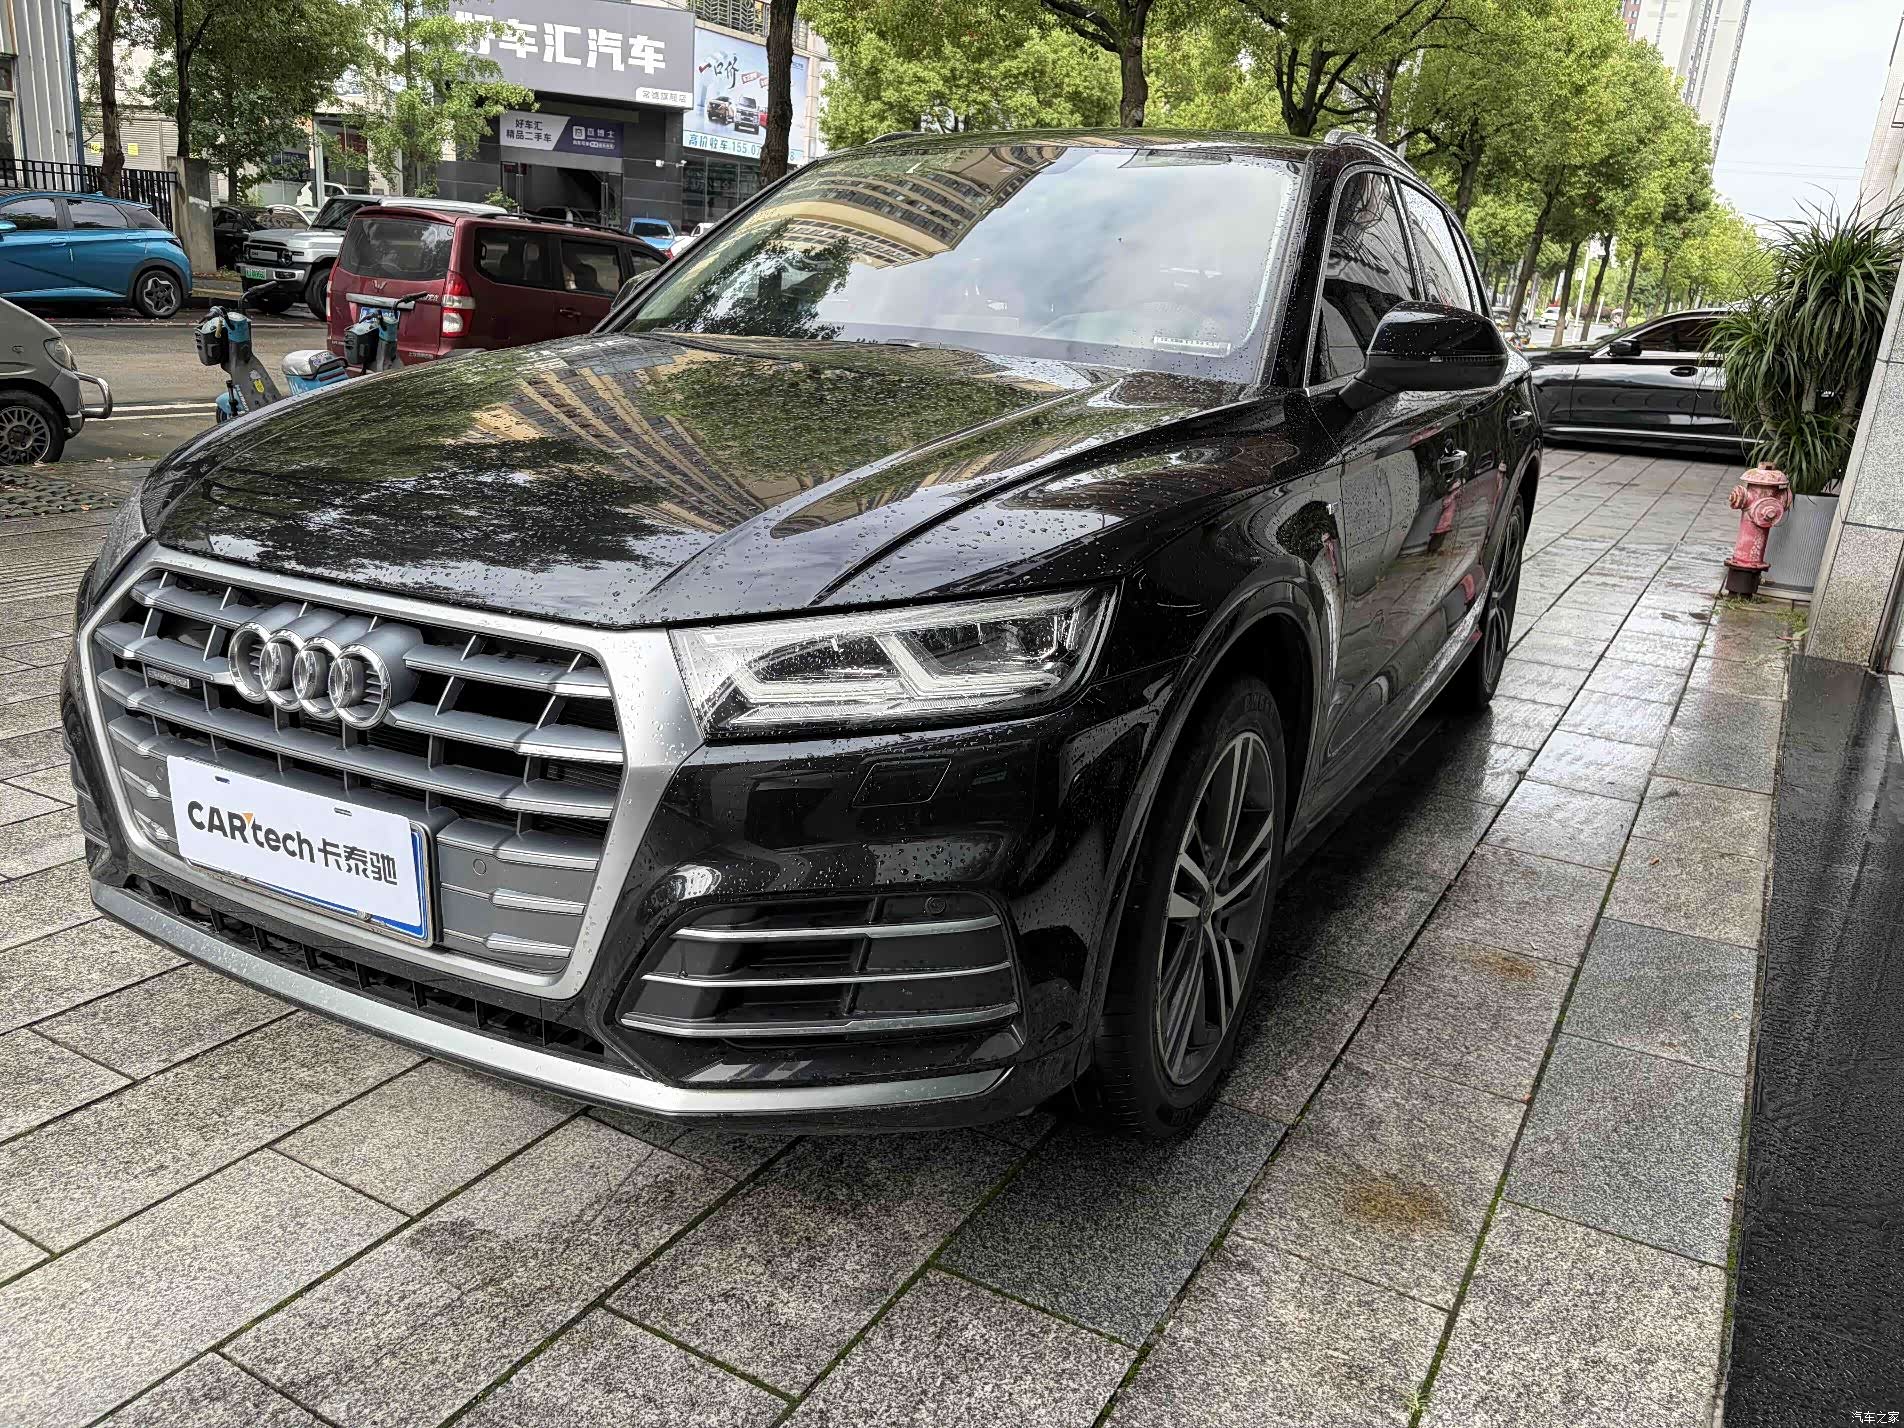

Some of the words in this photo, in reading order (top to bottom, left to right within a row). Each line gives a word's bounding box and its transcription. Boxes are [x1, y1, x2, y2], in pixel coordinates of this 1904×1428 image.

[515, 119, 543, 131] 好车汇
[506, 129, 552, 142] 精品二手车
[688, 134, 728, 150] 高价收车
[318, 838, 397, 885] 卡泰驰
